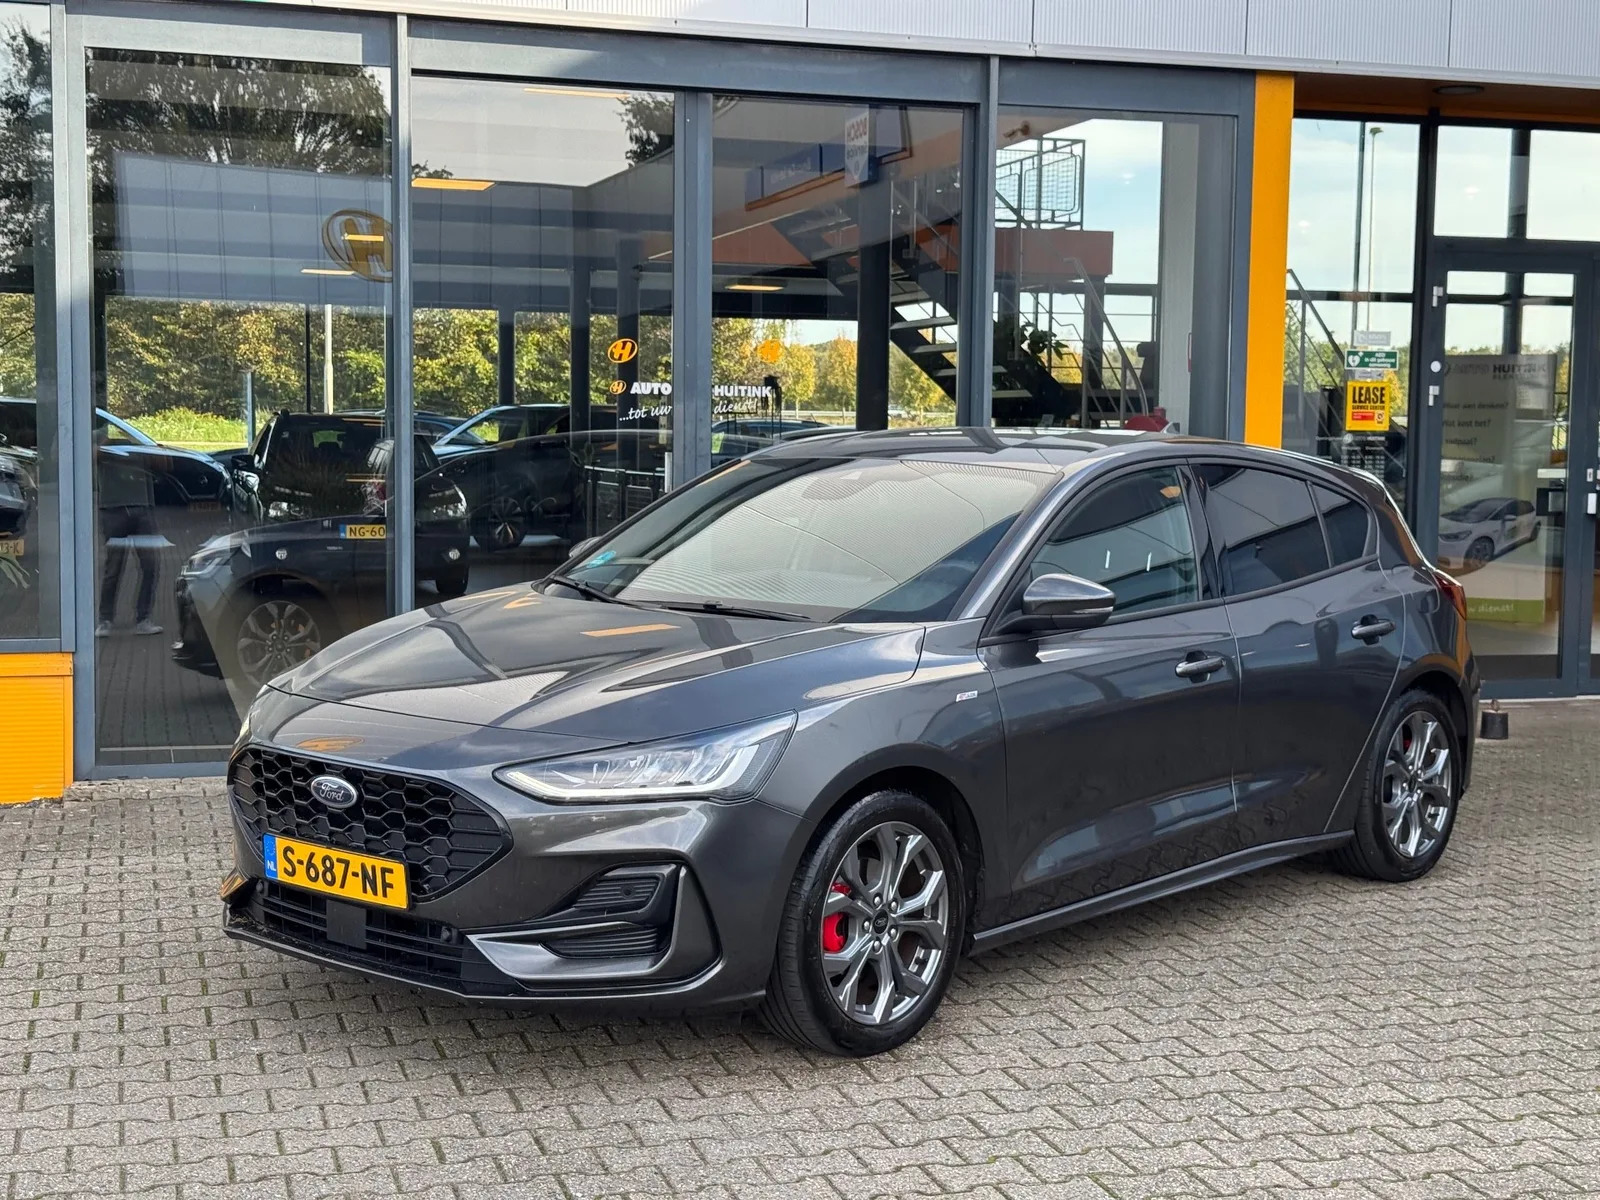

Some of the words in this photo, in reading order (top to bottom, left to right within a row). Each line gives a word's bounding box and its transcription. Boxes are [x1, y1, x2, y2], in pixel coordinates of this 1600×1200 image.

[630, 382, 672, 395] AUTO
[713, 385, 772, 397] HUITINK
[1352, 386, 1385, 404] LEASE
[651, 405, 672, 417] uw
[713, 399, 758, 414] dienst!
[319, 783, 345, 801] Ford
[267, 860, 277, 872] NL
[281, 846, 394, 899] S-687-NF
